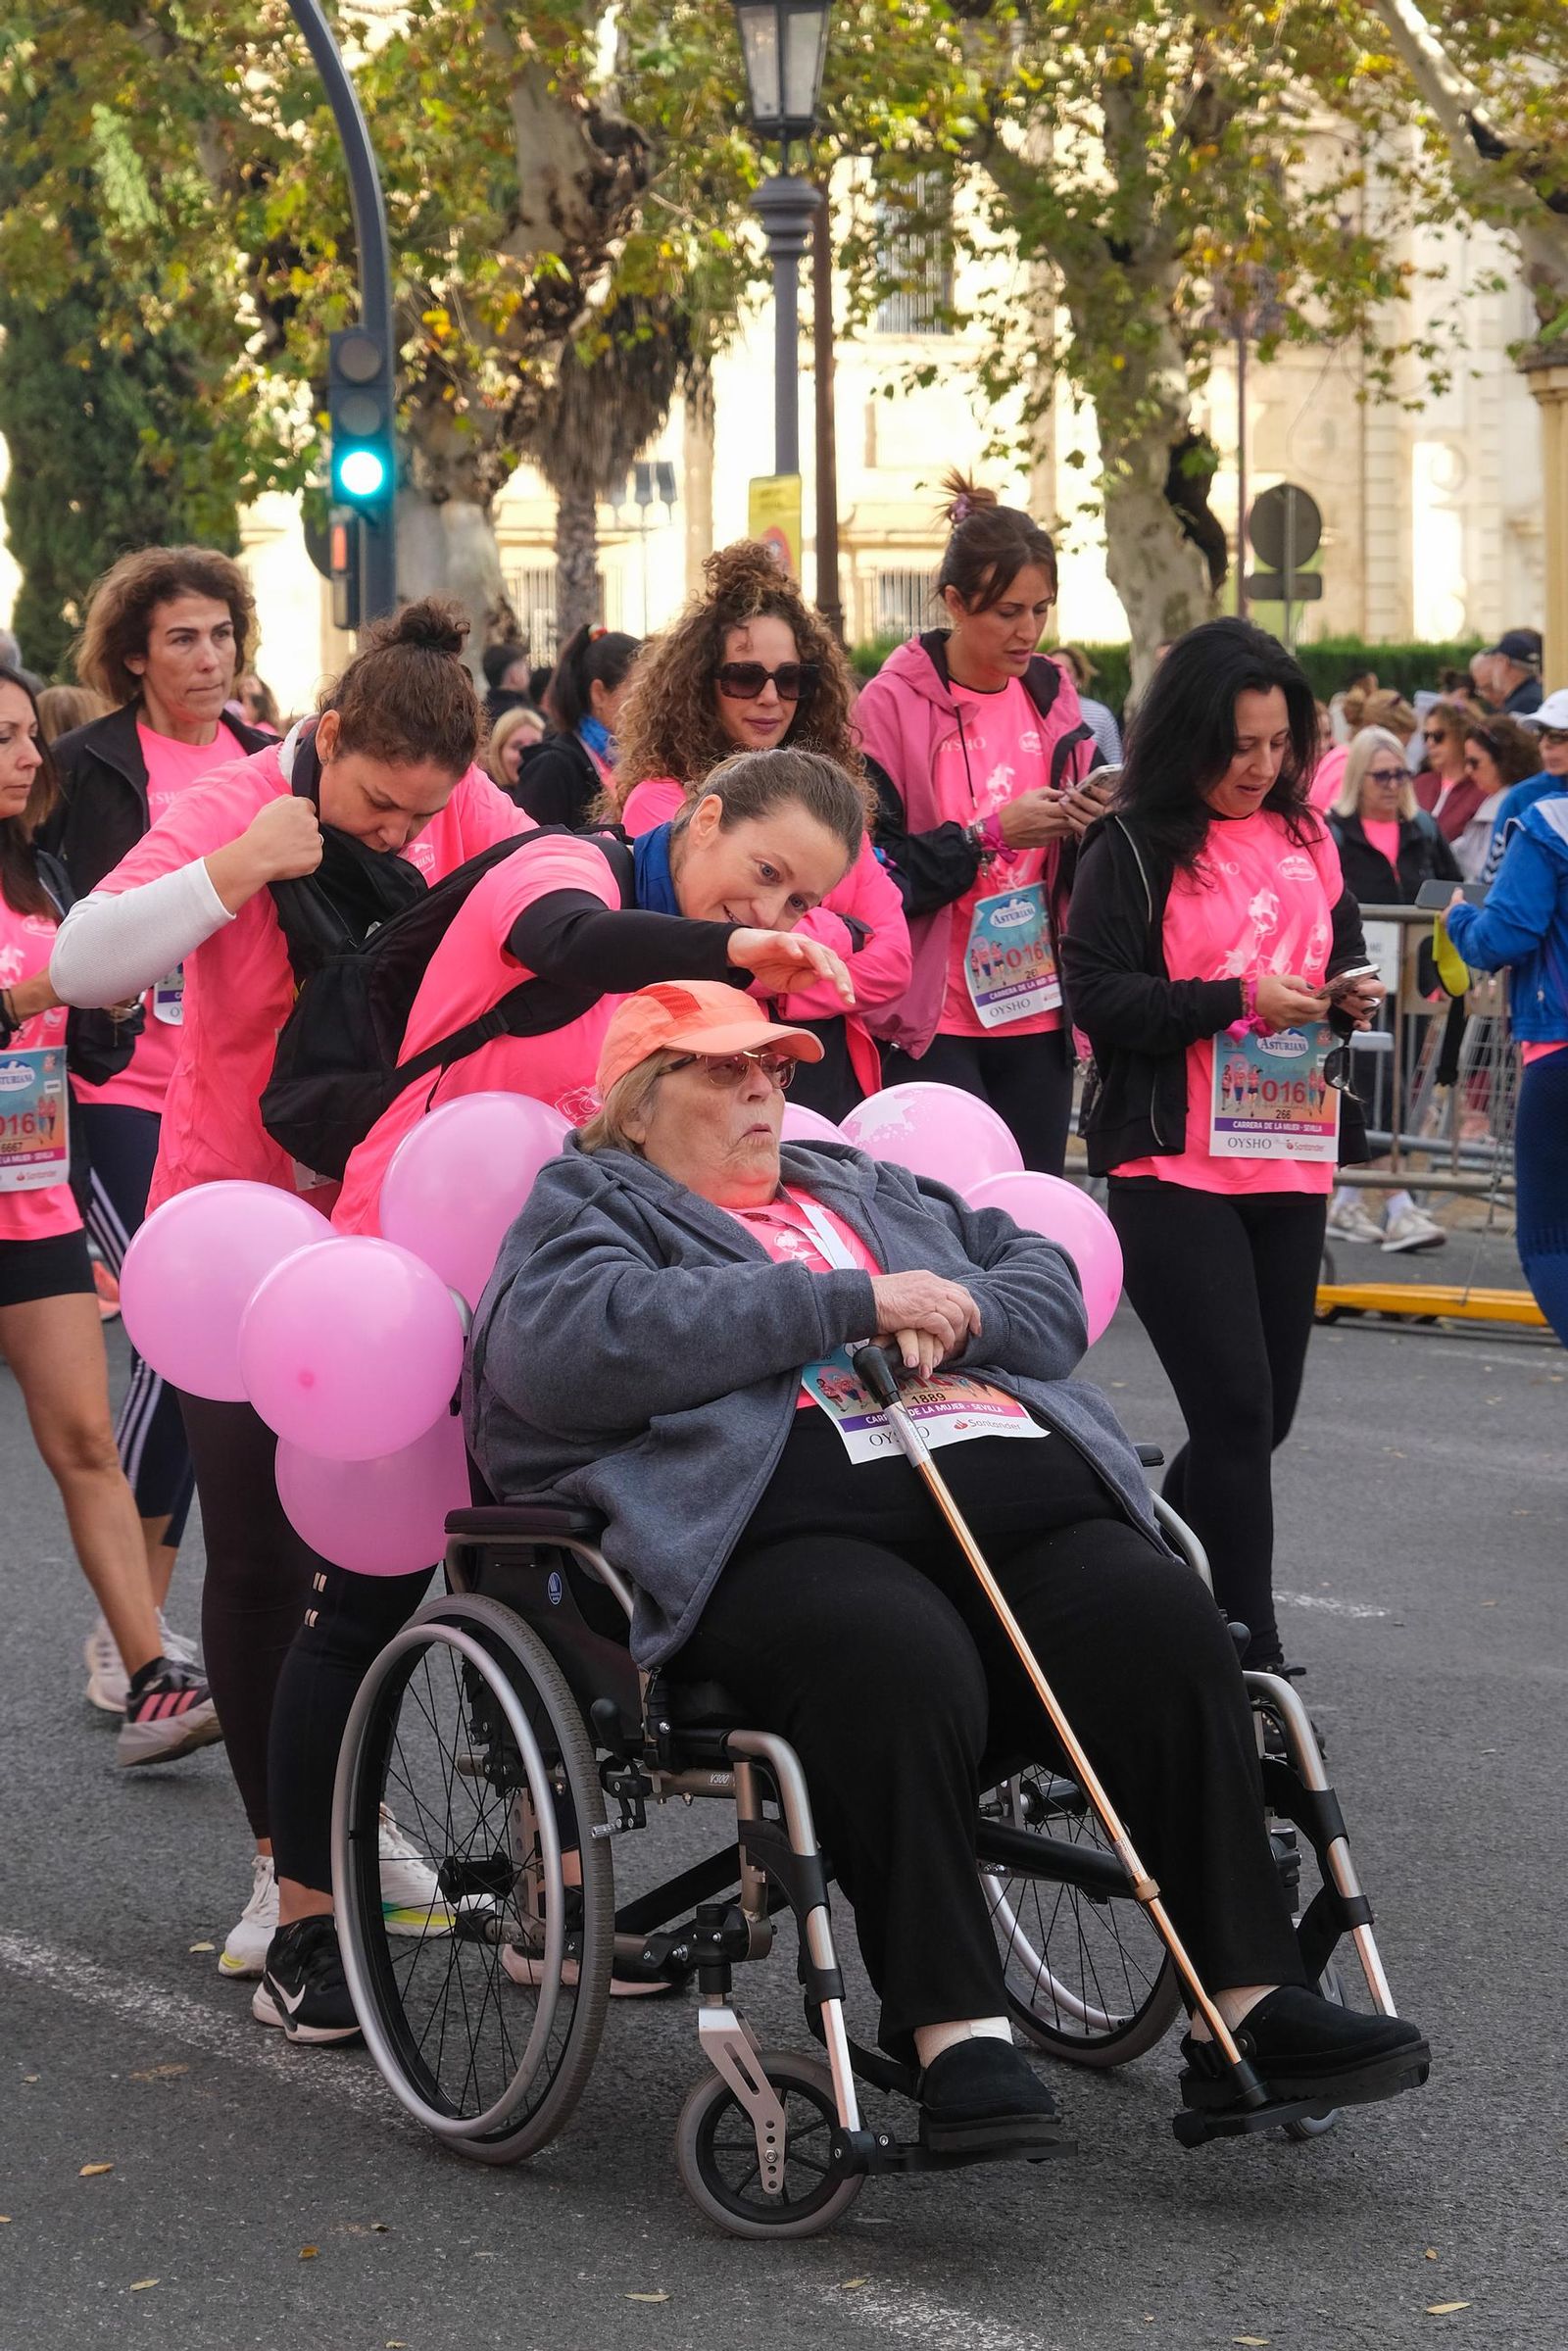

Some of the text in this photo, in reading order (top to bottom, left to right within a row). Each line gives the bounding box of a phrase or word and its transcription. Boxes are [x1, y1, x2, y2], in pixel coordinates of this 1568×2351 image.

[990, 998, 1030, 1018] OYSHO
[1261, 1080, 1305, 1103] 016
[1228, 1137, 1272, 1150] OYSHO
[911, 1393, 946, 1404] 1889
[906, 1407, 921, 1417] DE
[922, 1404, 936, 1414] LA
[937, 1402, 965, 1412] MUJER
[970, 1403, 1004, 1413] SEVILLA
[968, 1418, 1020, 1431] Santander
